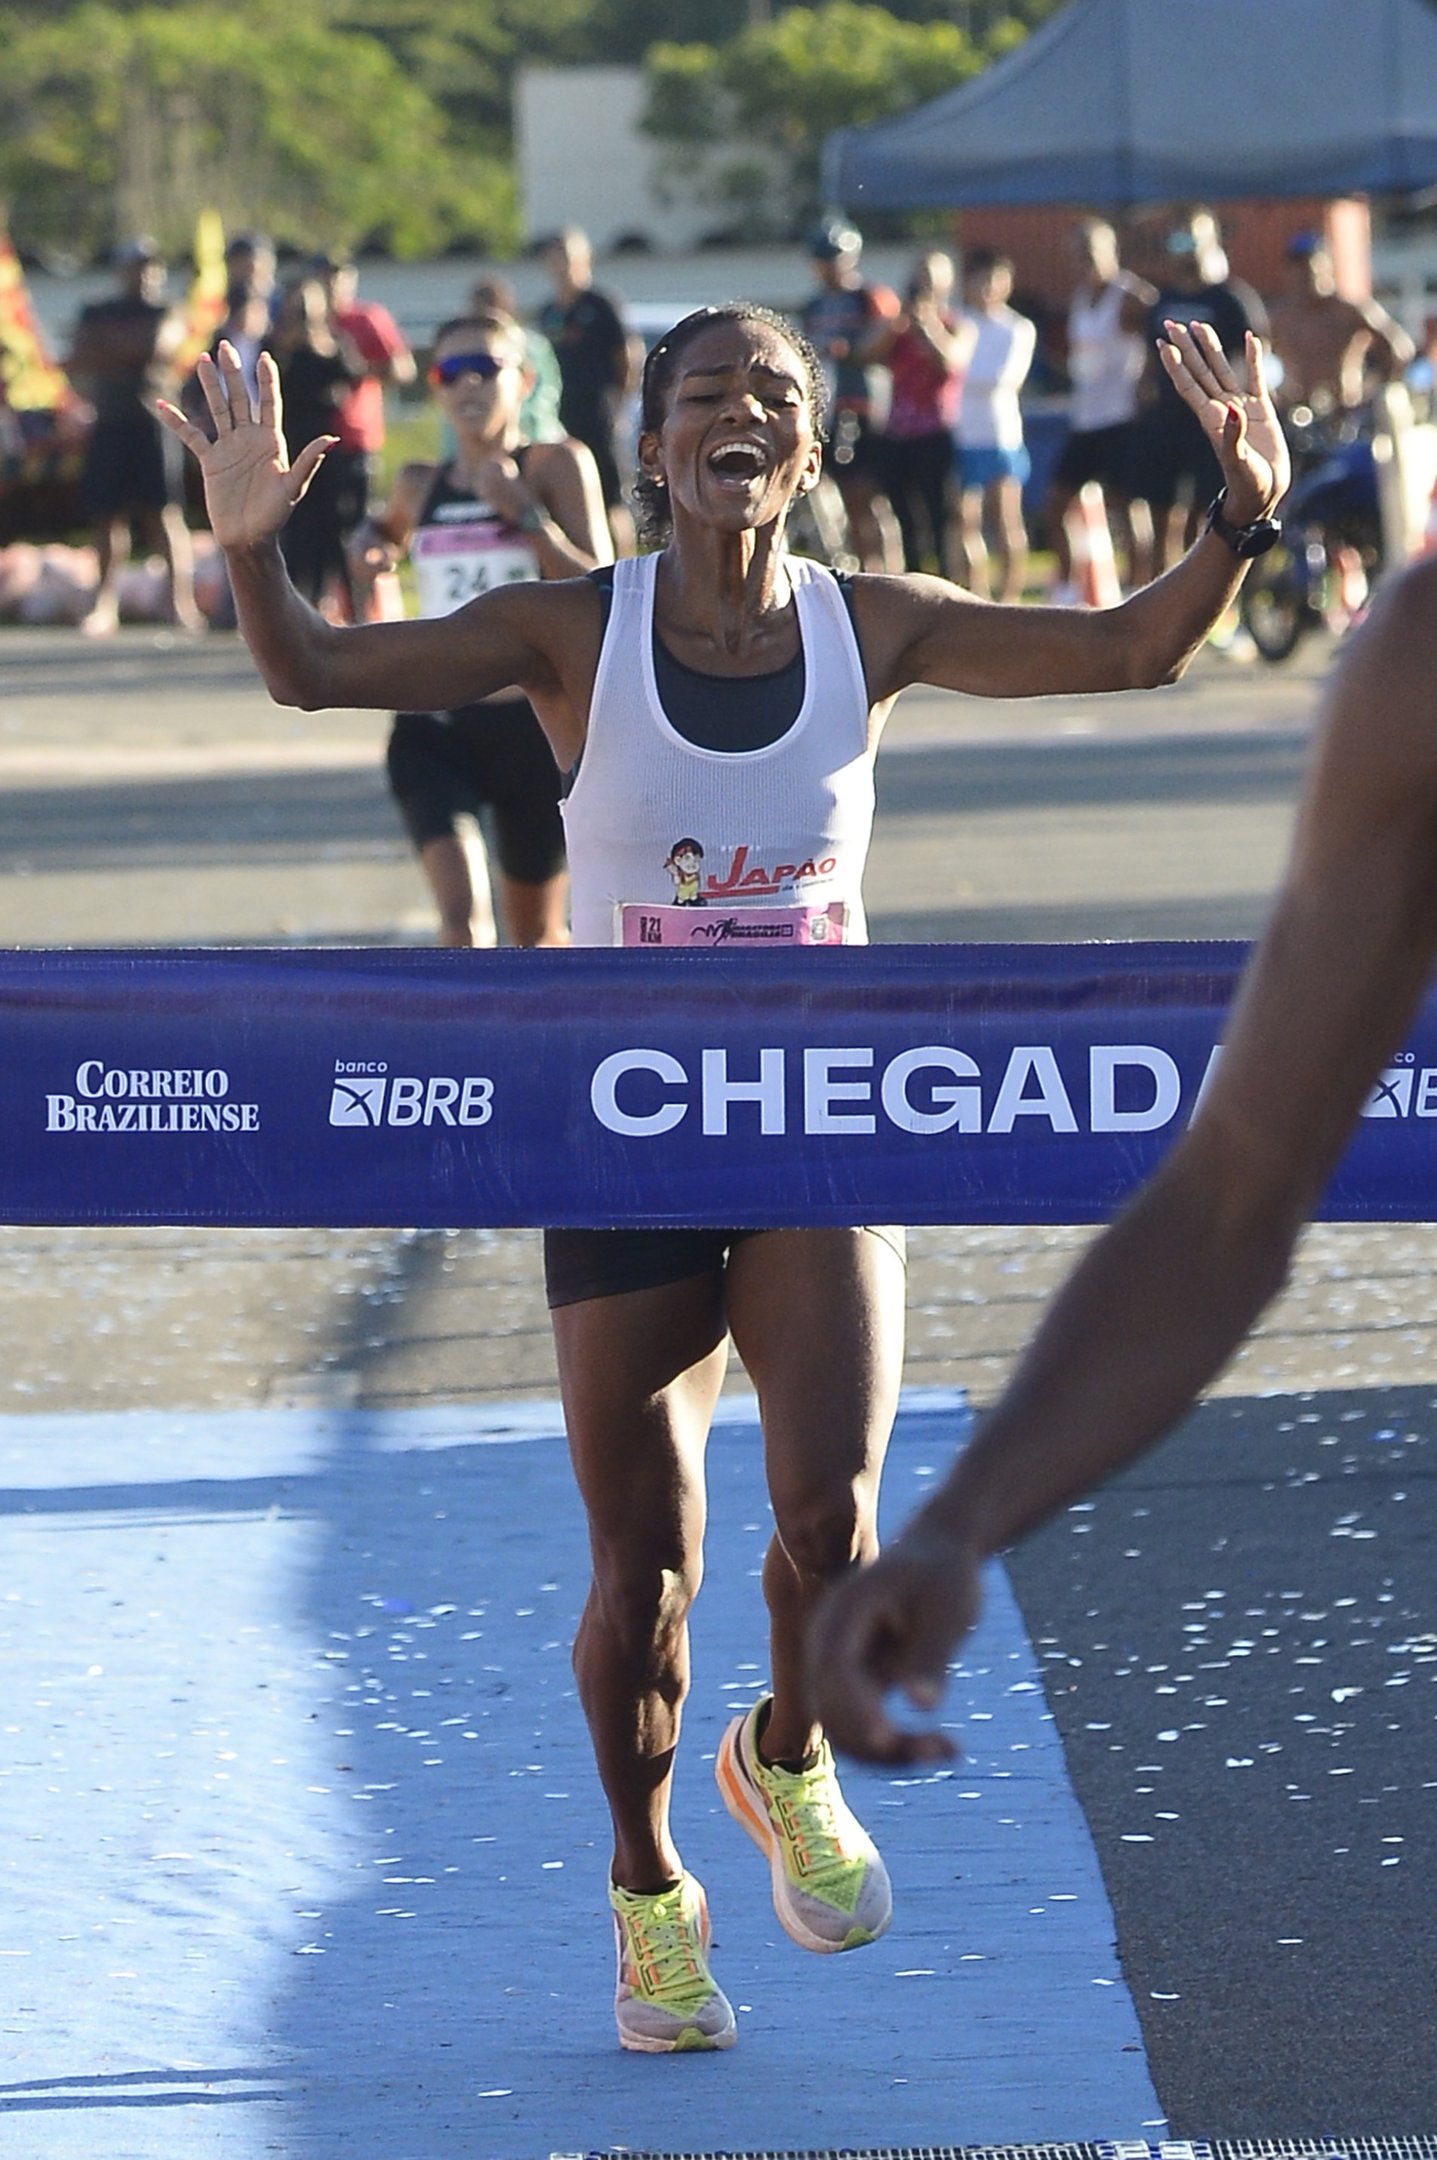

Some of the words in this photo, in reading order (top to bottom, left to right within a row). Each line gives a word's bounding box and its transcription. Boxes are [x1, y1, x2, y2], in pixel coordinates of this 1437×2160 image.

[707, 846, 837, 891] JAPÃO
[649, 916, 661, 932] 21
[75, 1060, 229, 1099] CORREIO
[334, 1059, 388, 1074] banco
[387, 1077, 495, 1127] BRB
[590, 1045, 1228, 1137] CHEGAD
[45, 1095, 260, 1132] BRAZILIENSE
